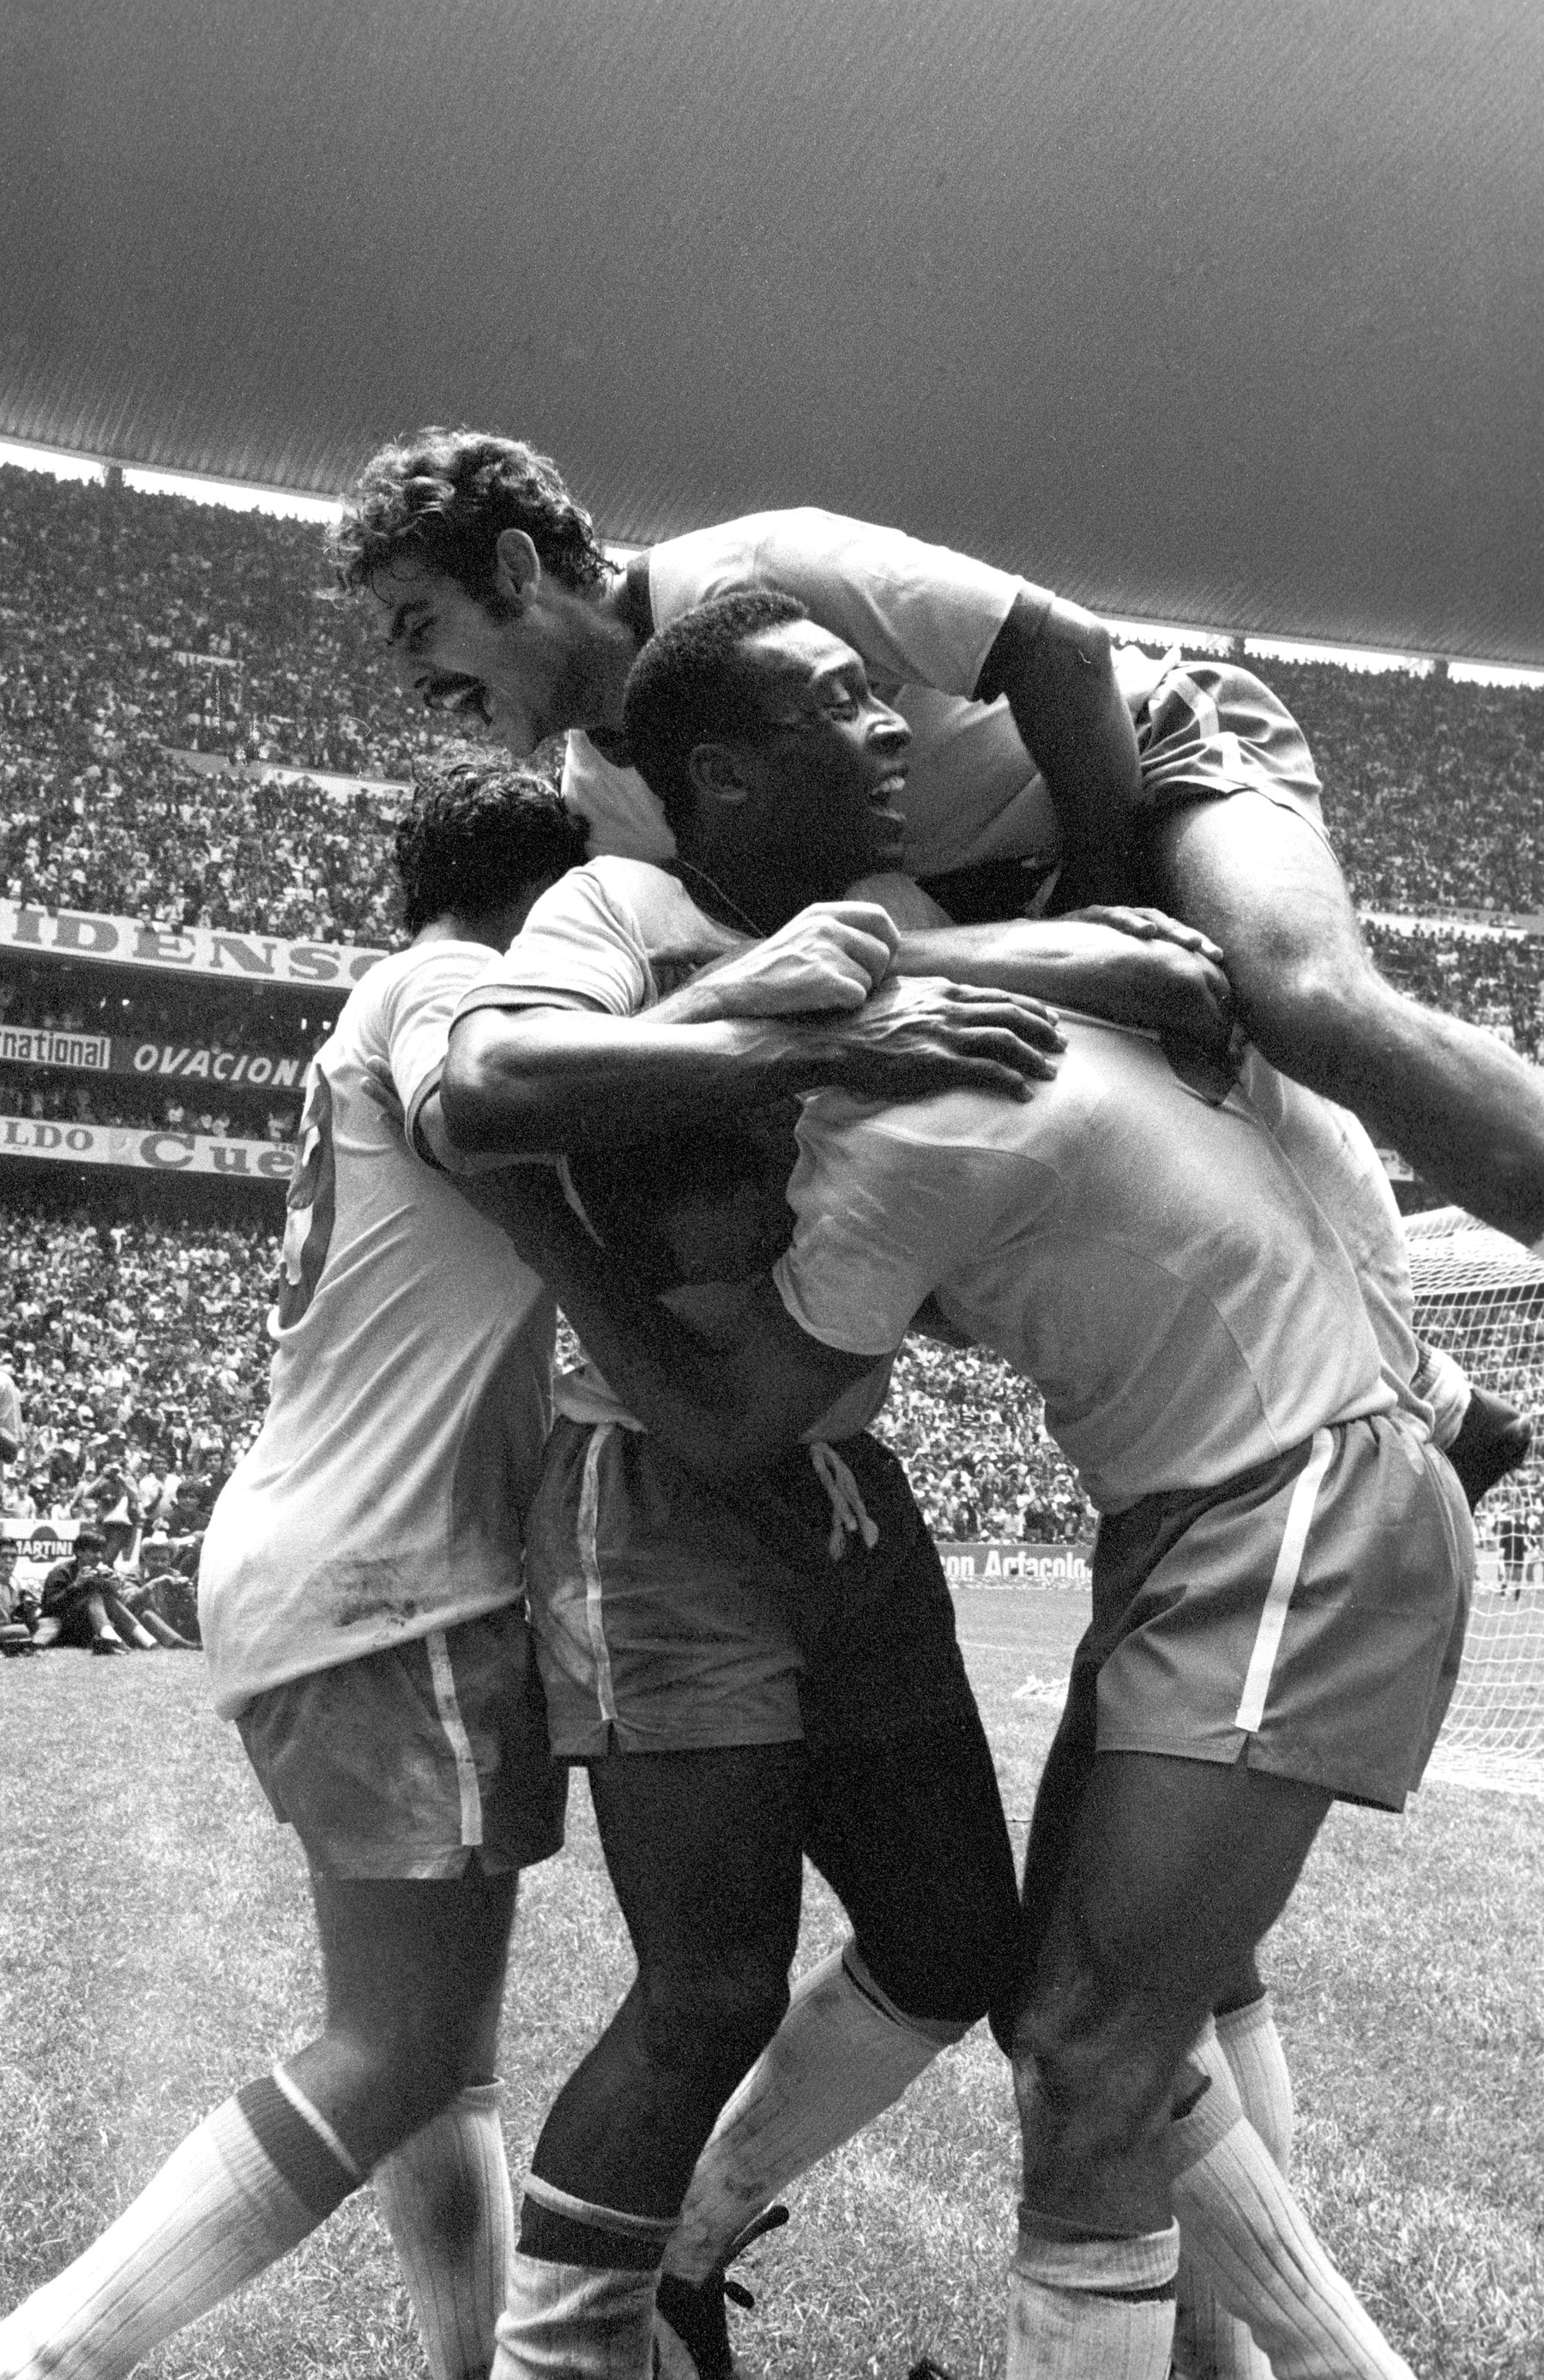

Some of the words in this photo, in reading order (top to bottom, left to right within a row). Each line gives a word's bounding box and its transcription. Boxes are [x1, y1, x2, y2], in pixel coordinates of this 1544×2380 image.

[0, 1031, 106, 1068] national
[4, 1121, 94, 1151] LDO
[139, 1131, 295, 1178] Cue
